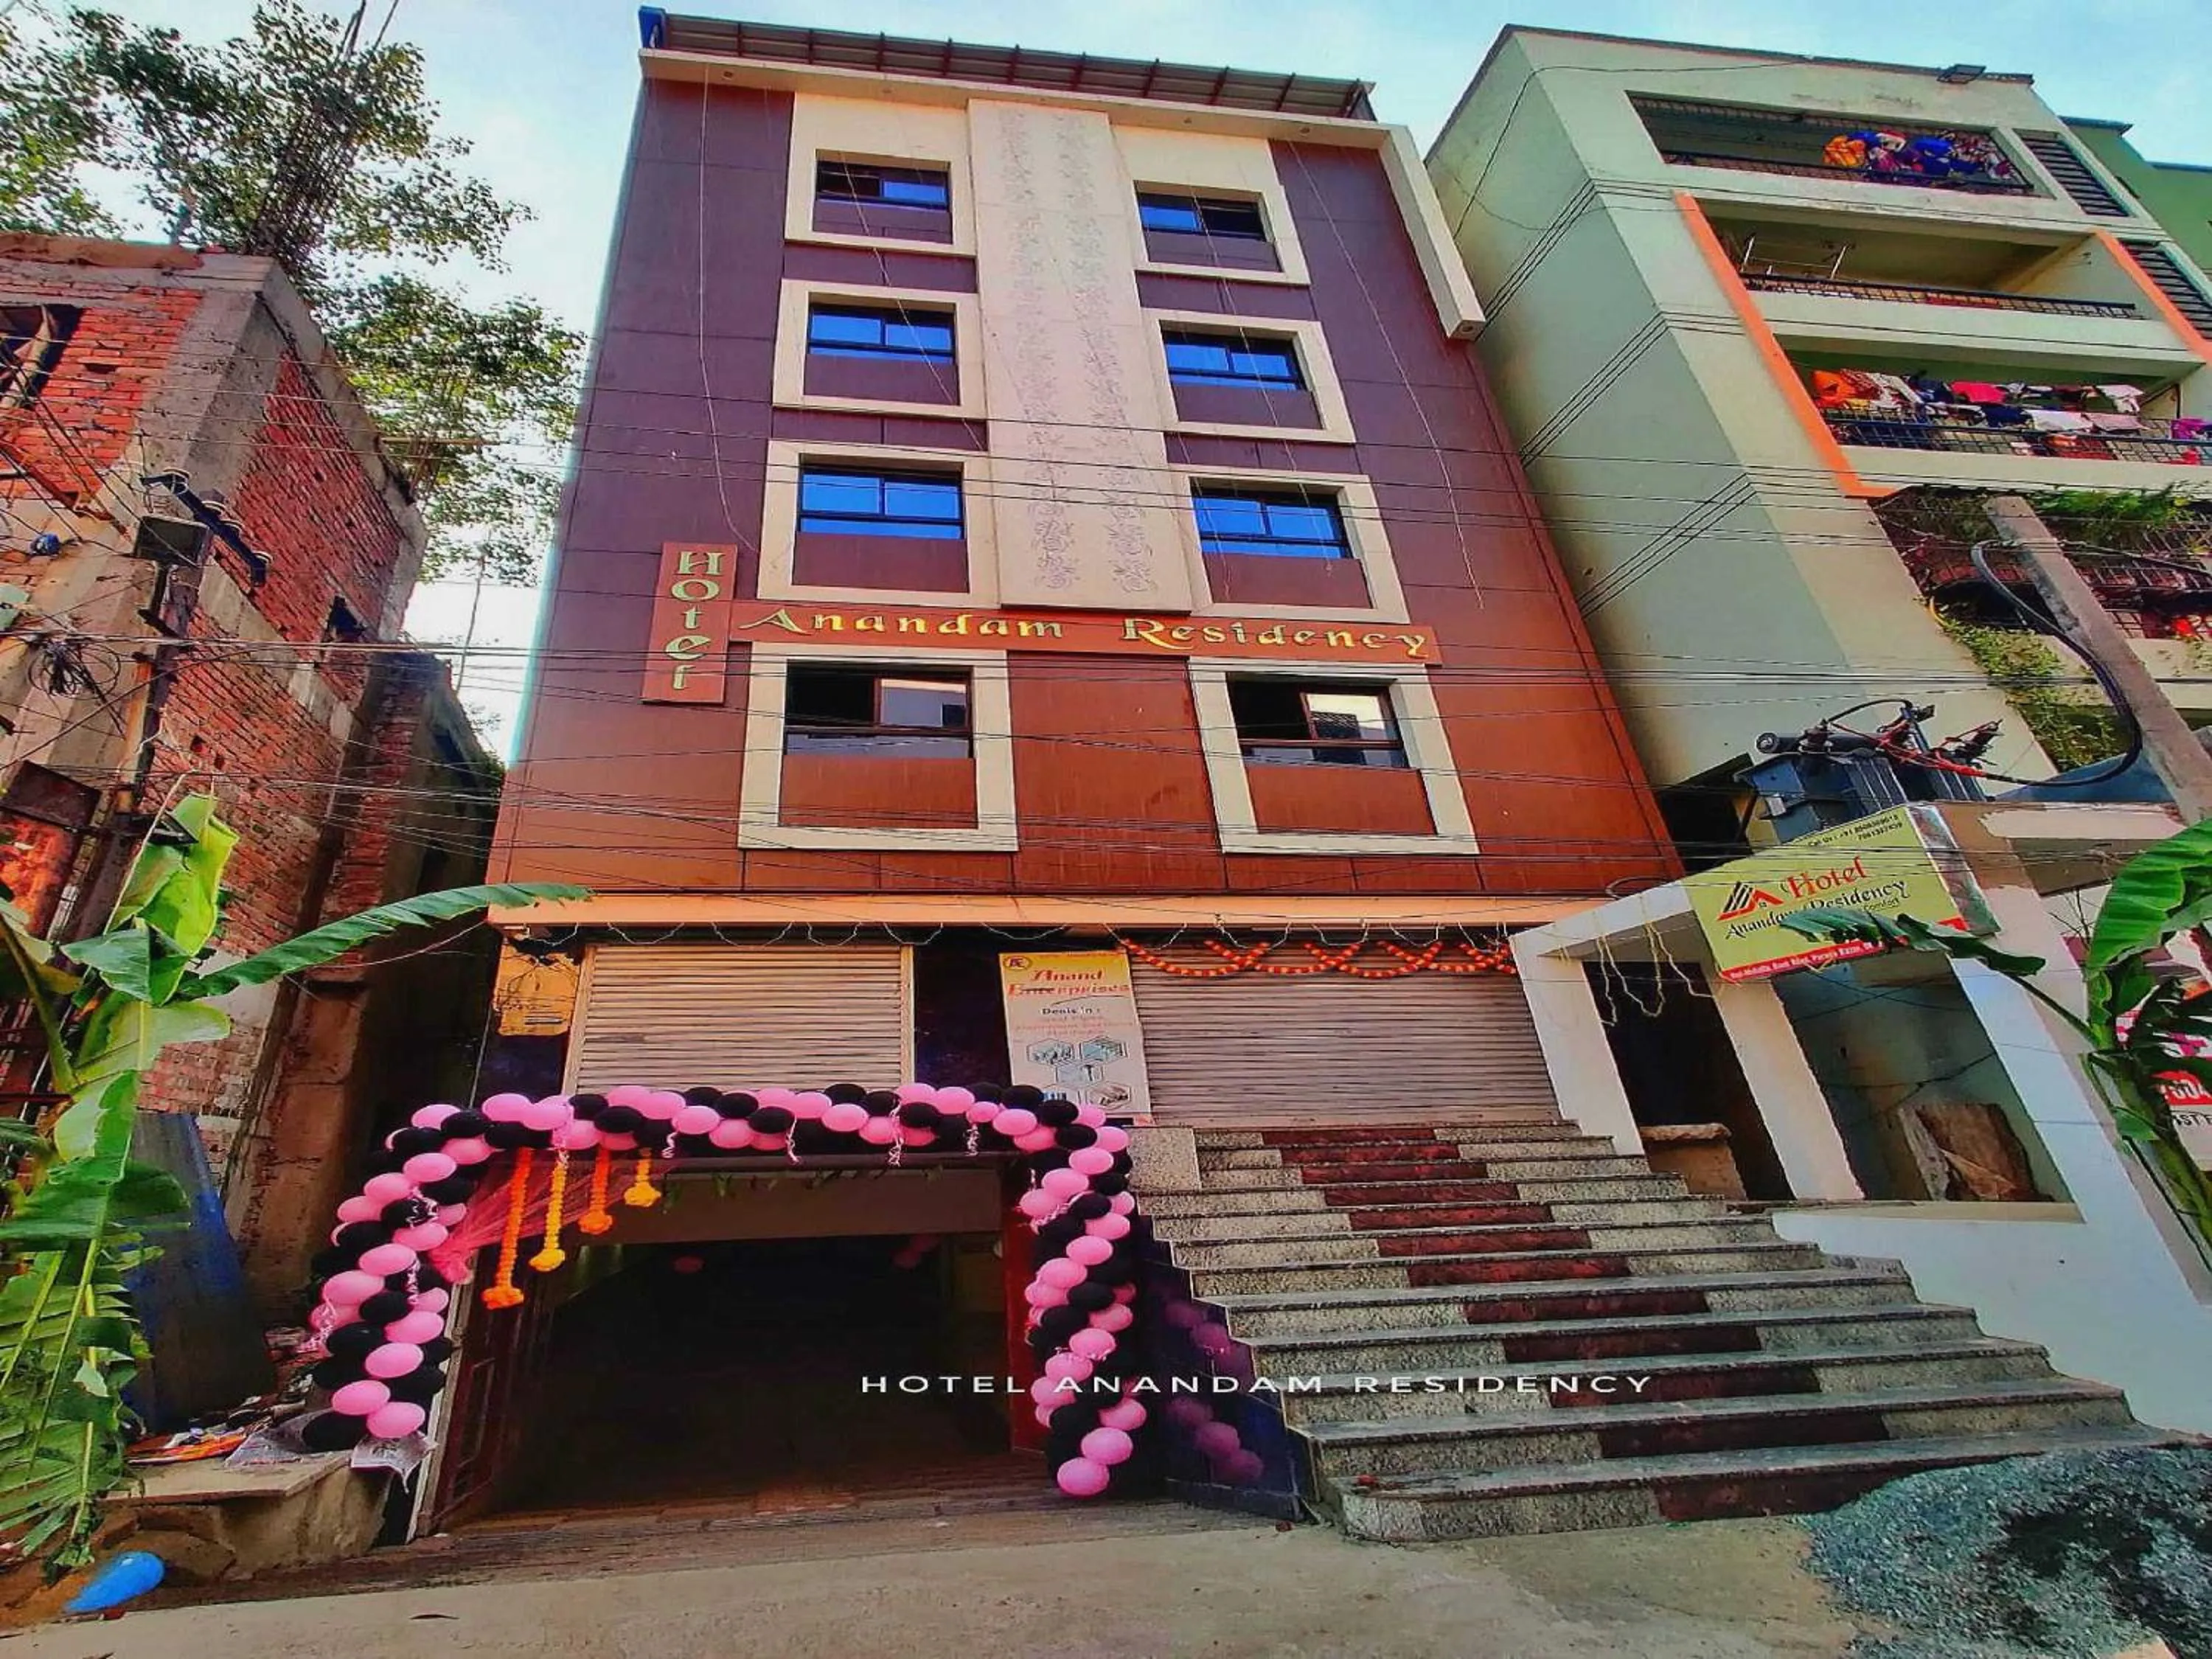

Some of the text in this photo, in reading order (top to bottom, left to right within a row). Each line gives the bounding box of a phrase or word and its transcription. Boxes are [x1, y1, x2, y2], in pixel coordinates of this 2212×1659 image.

[738, 608, 1429, 659] Anandam Residency
[1780, 855, 1868, 899] Hotel
[1030, 968, 1103, 981] Anand
